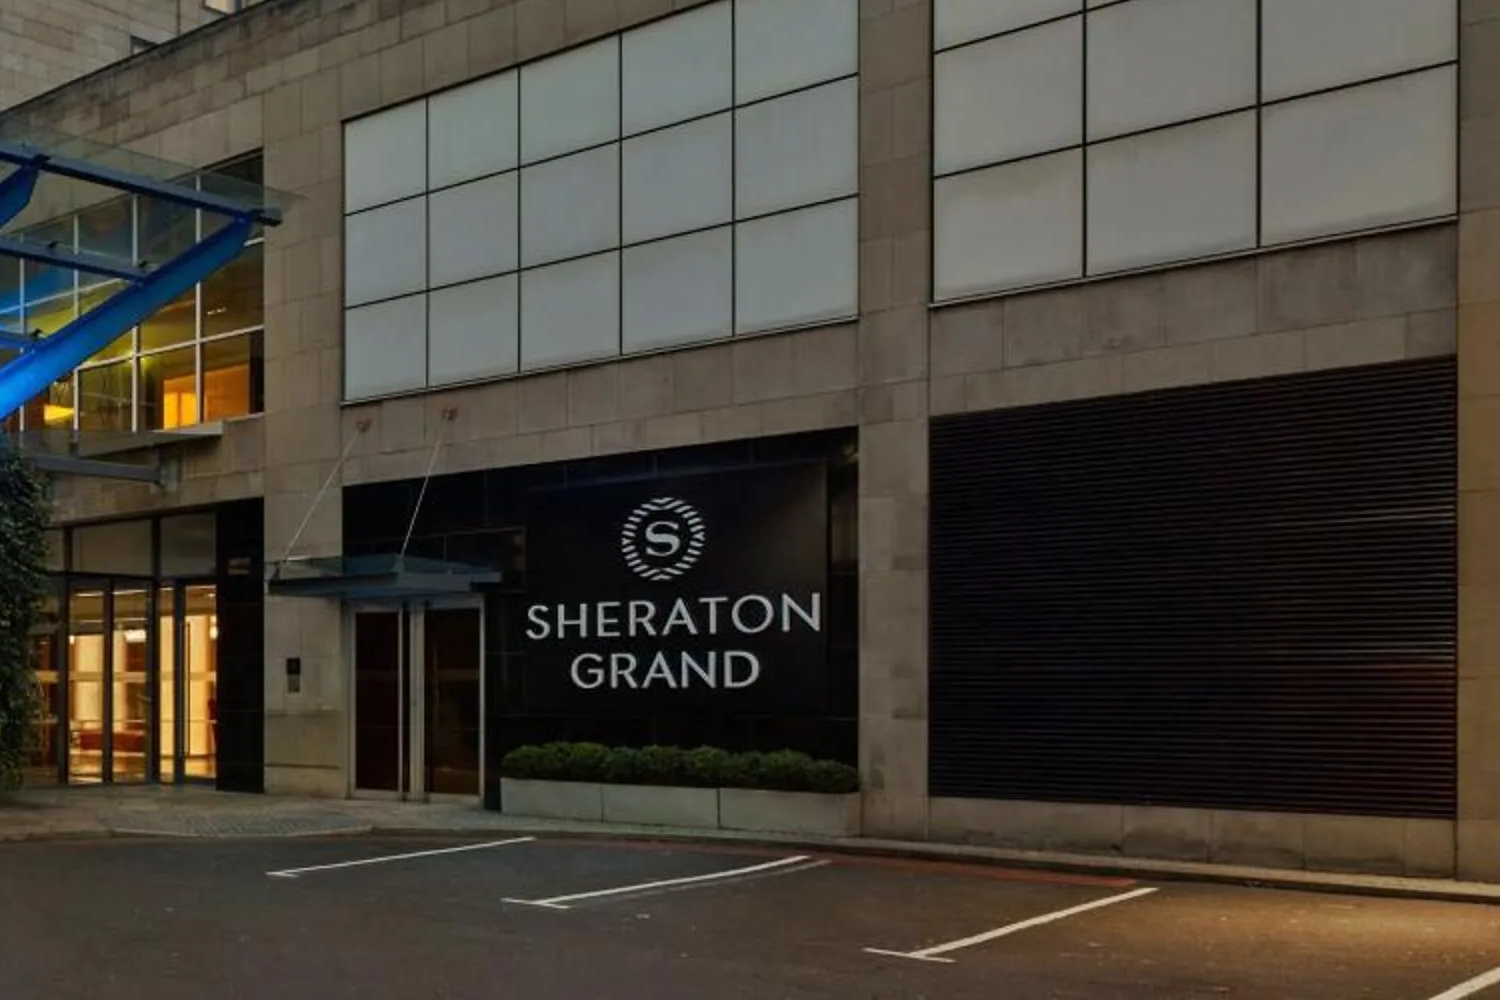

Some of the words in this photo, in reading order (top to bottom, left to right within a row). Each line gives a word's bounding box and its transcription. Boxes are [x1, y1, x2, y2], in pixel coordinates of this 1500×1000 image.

[645, 521, 681, 556] S
[525, 593, 821, 640] SHERATON
[570, 651, 760, 689] GRAND
